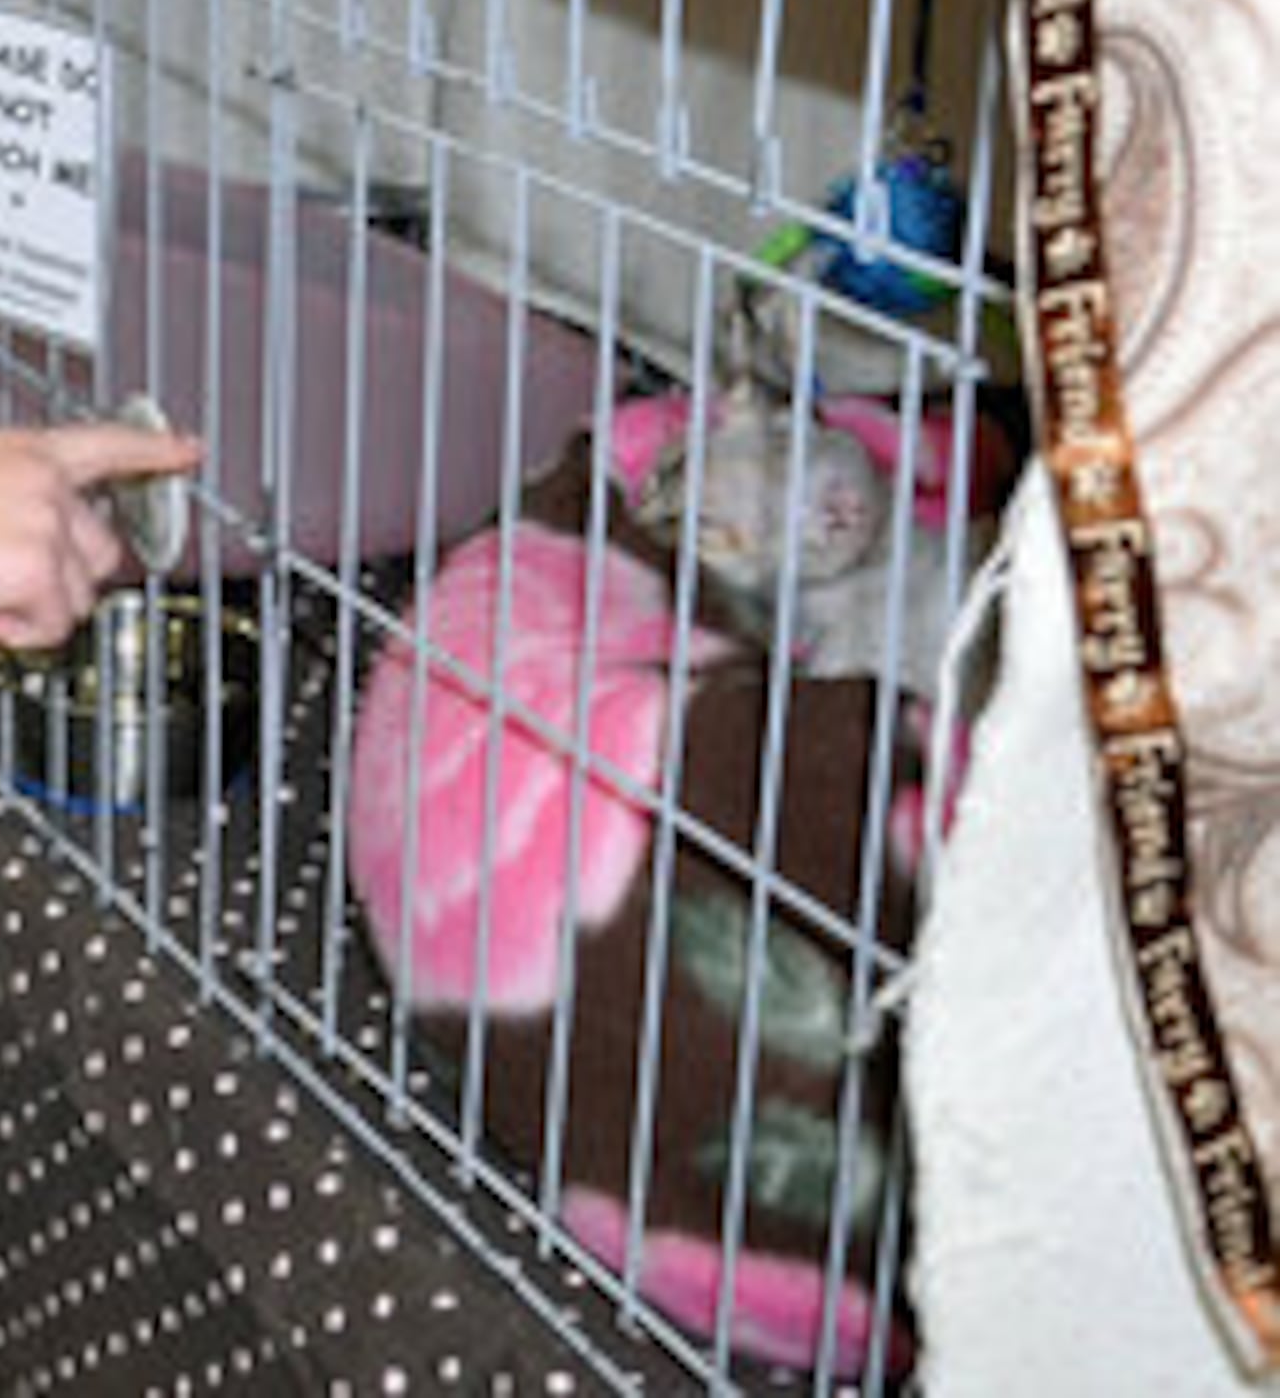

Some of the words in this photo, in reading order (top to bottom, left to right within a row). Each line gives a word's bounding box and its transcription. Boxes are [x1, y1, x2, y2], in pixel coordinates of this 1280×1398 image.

[51, 160, 91, 197] ME
[1031, 74, 1097, 228] Furry
[1041, 279, 1121, 450] Friend
[1069, 518, 1147, 672] Furry
[1104, 732, 1183, 887] Friend
[1141, 924, 1214, 1084] Furry
[1194, 1127, 1276, 1292] Friend
